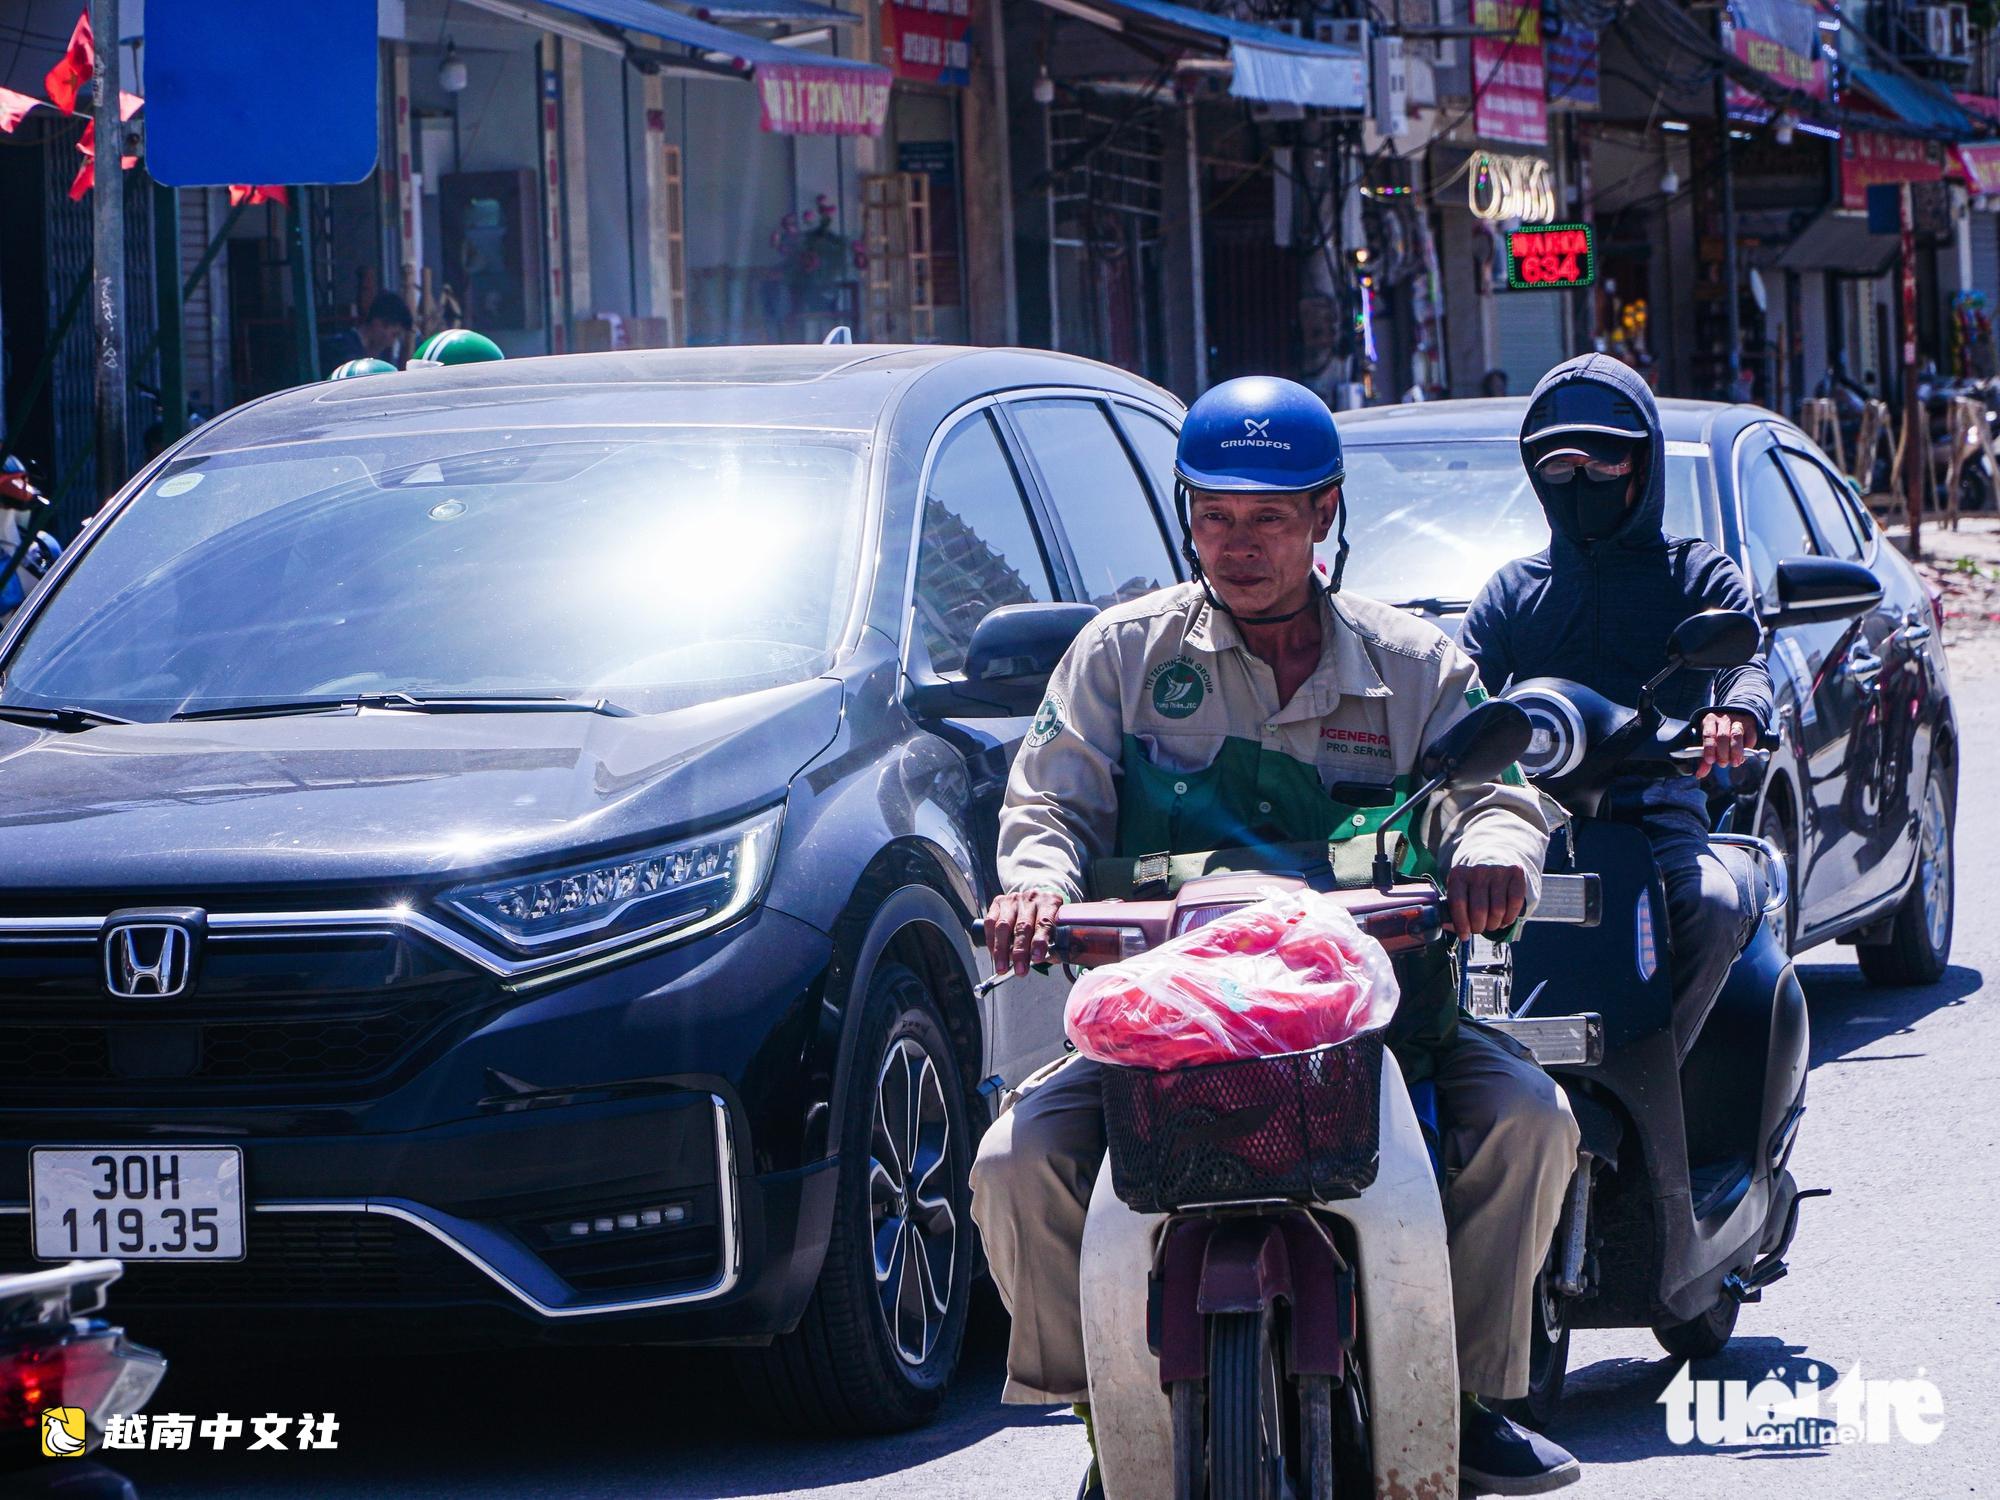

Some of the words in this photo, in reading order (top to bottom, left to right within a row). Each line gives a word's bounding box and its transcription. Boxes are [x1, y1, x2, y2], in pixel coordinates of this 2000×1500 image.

[1522, 253, 1580, 284] 634
[1220, 439, 1291, 450] GRUNDFOS
[1195, 663, 1213, 694] GROUP
[92, 1154, 180, 1200] 30H
[62, 1207, 219, 1253] 119.35
